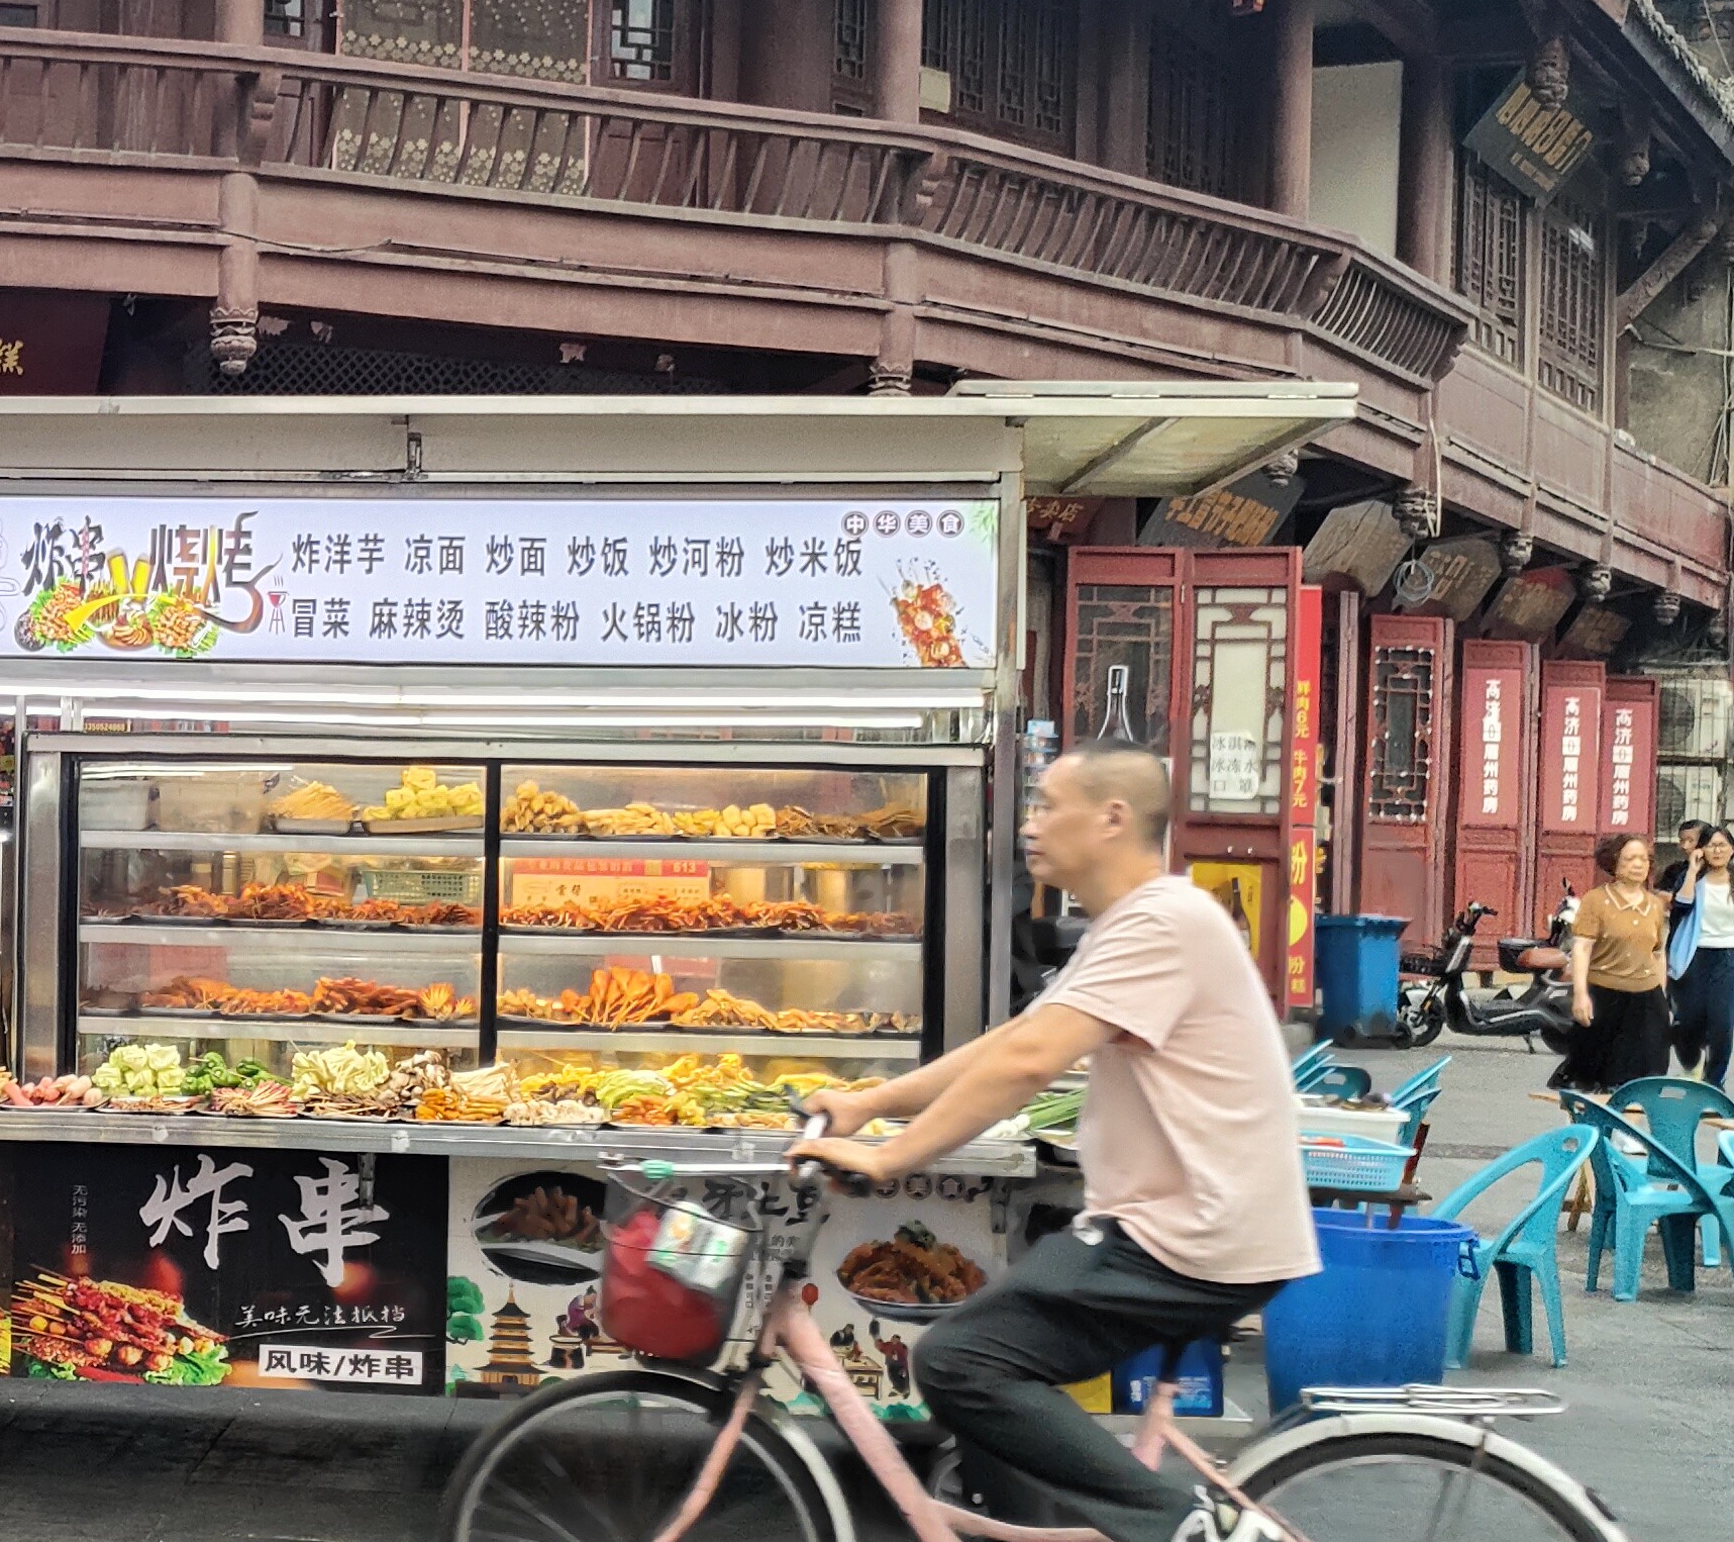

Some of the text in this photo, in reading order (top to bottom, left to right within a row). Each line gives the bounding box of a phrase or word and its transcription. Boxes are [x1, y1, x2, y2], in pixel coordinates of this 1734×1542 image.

[843, 512, 963, 537] 中华美食
[292, 533, 863, 577] 炸洋芋 凉面 炒面 炒饭 炒河粉 炒米饭
[291, 598, 862, 643] 冒菜 麻辣烫 酸辣粉 火锅粉 冰粉 凉糕
[139, 1152, 390, 1289] 炸串
[234, 1304, 405, 1329] 美味无法抵挡
[264, 1349, 415, 1380] 风味/炸串
